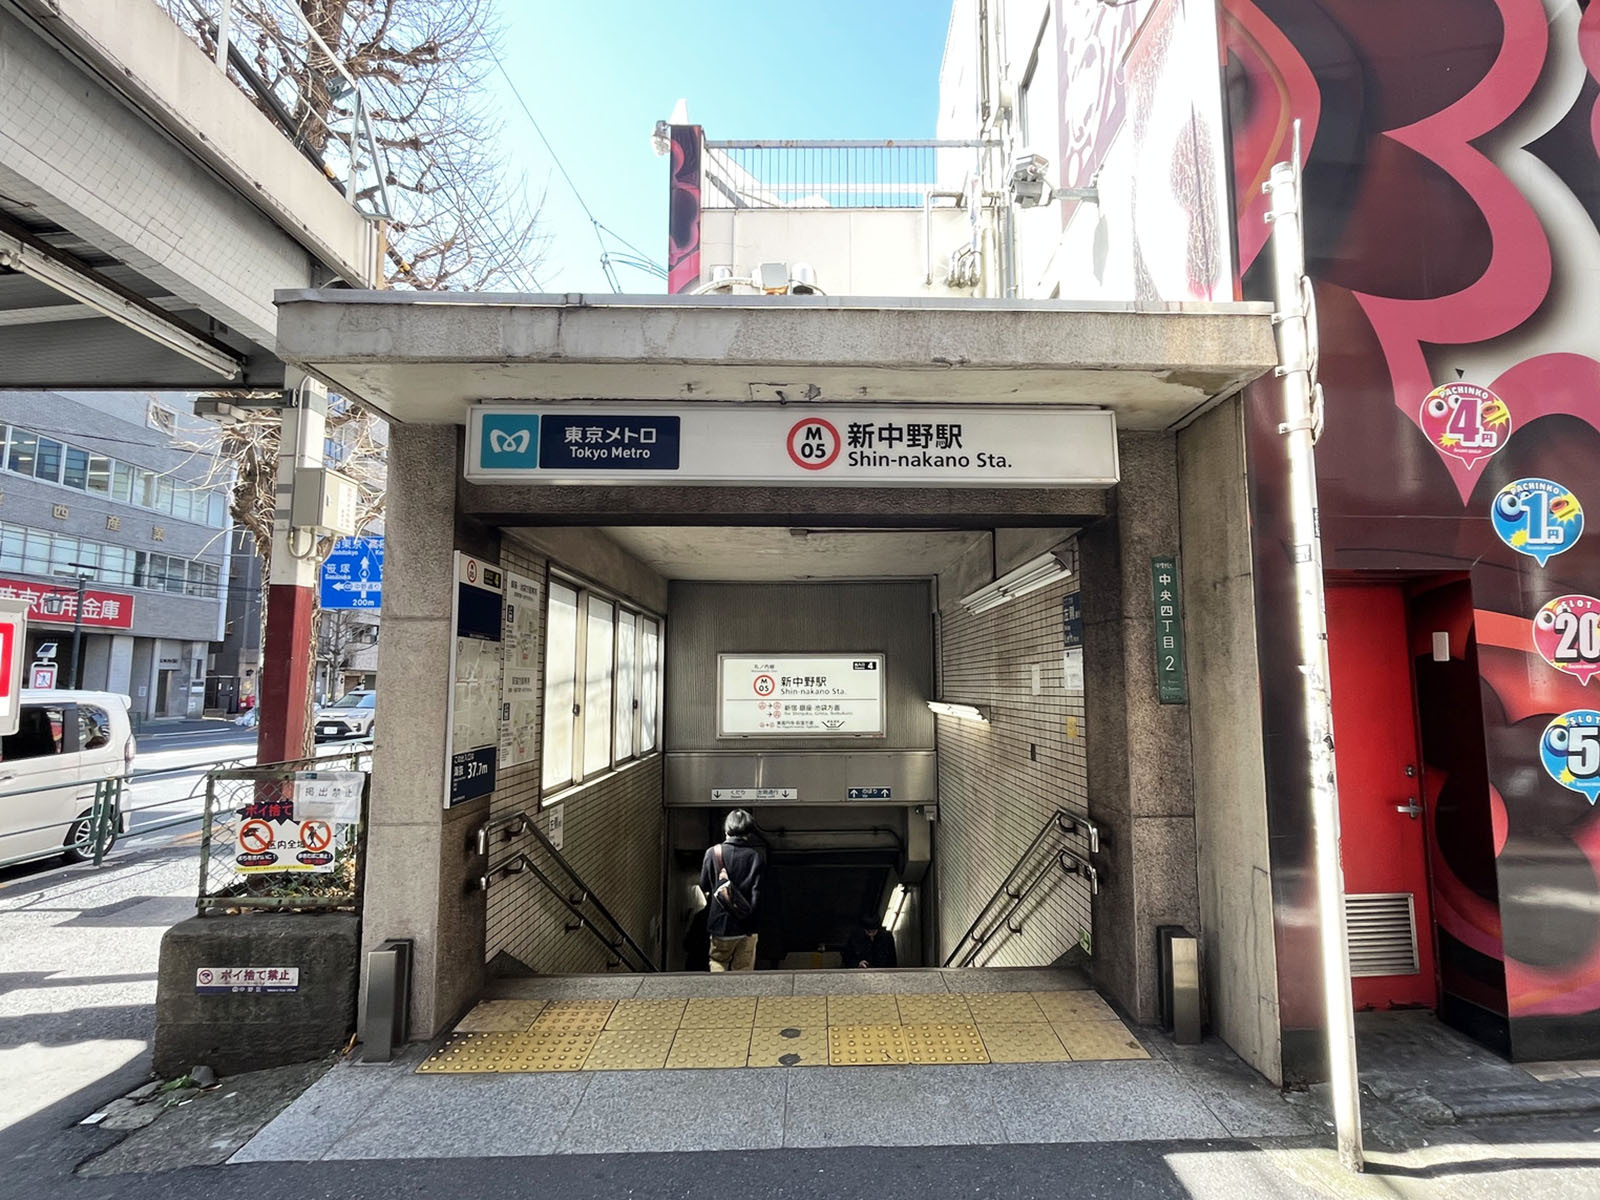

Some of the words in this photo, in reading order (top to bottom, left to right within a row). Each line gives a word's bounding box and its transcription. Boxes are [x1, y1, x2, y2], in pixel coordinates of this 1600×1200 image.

[1439, 386, 1488, 399] PACHINKO
[564, 427, 656, 443] 東京メトロ
[805, 427, 823, 440] M
[848, 423, 962, 449] 新中野駅
[570, 446, 608, 460] Tokyo
[611, 446, 650, 459] Metro
[801, 444, 826, 459] 05
[848, 452, 970, 468] Shin-nakano
[976, 453, 1012, 468] Sta.
[1511, 482, 1560, 494] PACHINKO
[352, 598, 375, 607] 200m
[1562, 599, 1592, 609] SLOT
[1159, 573, 1174, 648] 中央四丁目
[1165, 655, 1175, 671] 2
[781, 676, 827, 688] 新中野駅
[467, 761, 488, 779] 37.7m
[221, 969, 290, 981] ポイ捨て禁止
